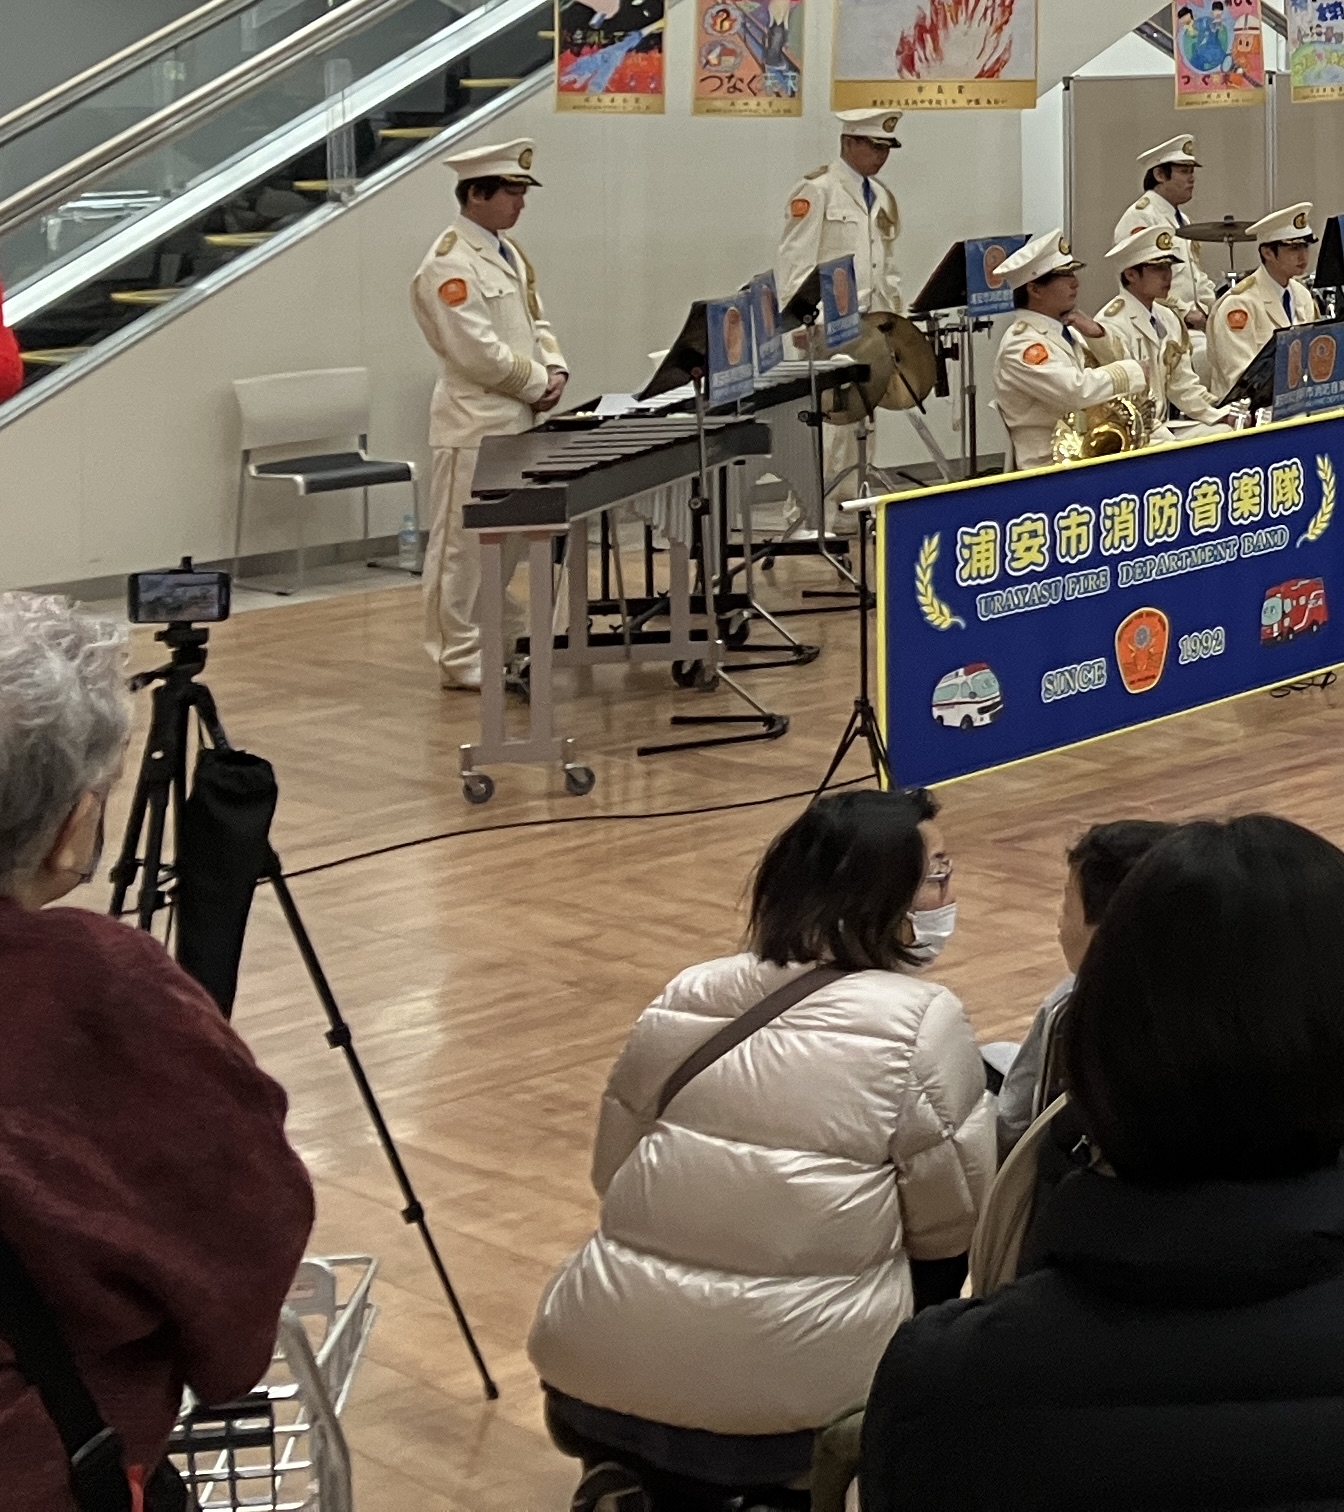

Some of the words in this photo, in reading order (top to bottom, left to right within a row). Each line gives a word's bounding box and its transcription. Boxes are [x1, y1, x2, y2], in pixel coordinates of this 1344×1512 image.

[956, 457, 1304, 586] 浦安市消防音楽隊
[976, 578, 1063, 621] URAYASU
[1064, 567, 1110, 601] FIRE
[1118, 534, 1239, 586] DEPARTMENT
[1240, 524, 1290, 561] BAND
[1041, 657, 1107, 703] SINCE
[1178, 625, 1225, 665] 1992
